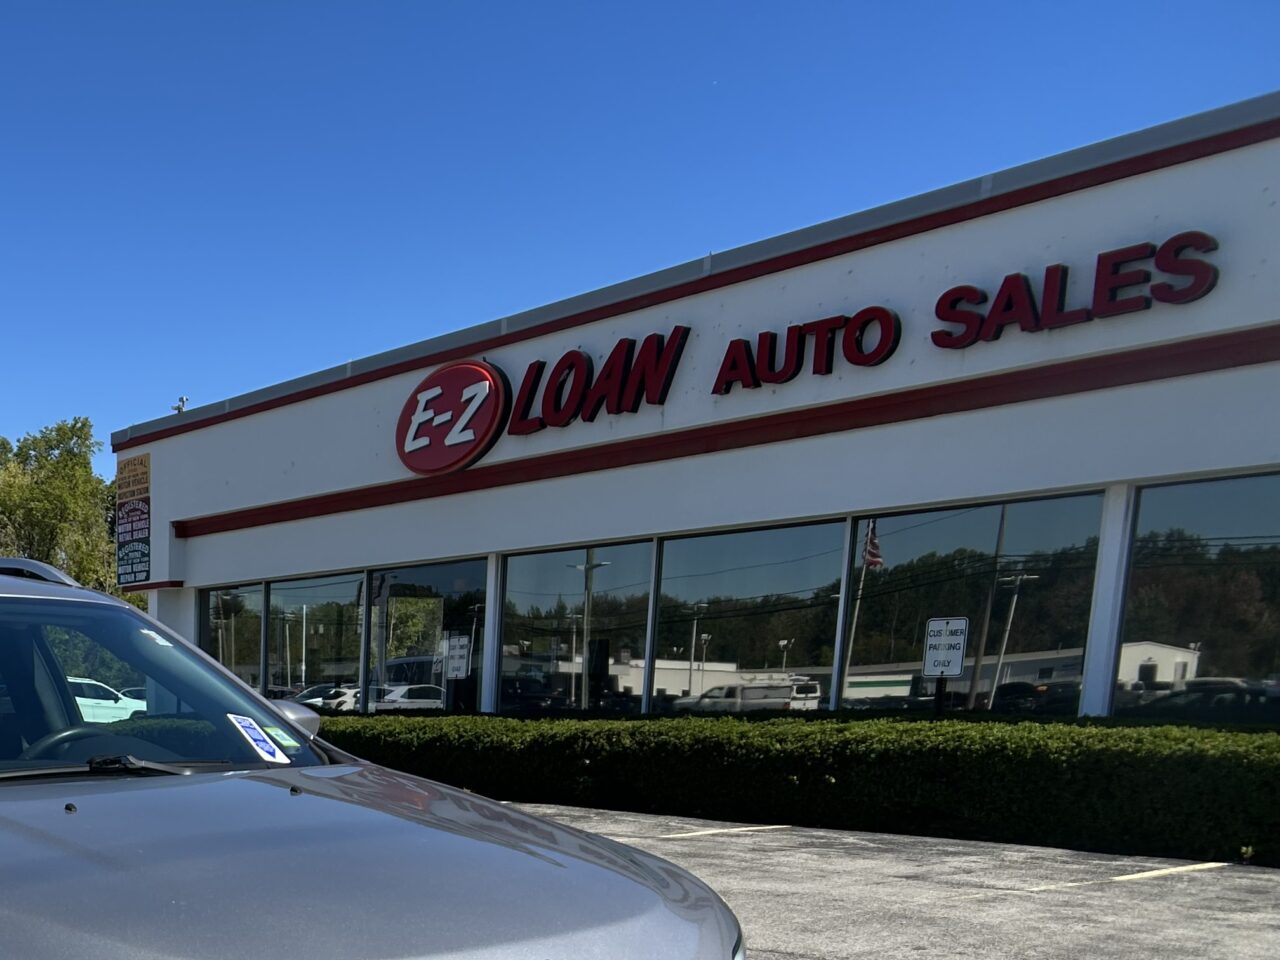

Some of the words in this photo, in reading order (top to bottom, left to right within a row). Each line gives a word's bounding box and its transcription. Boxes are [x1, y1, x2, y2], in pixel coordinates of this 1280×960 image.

[404, 380, 490, 454] E-Z
[507, 325, 691, 436] LOAN
[711, 305, 902, 395] AUTO
[930, 230, 1219, 350] SALES
[120, 456, 147, 475] OFFICIAL
[118, 500, 149, 519] REGISTERED
[118, 542, 149, 559] REGISTERED
[132, 562, 149, 572] VEHICLE
[929, 629, 964, 637] CUSOMER
